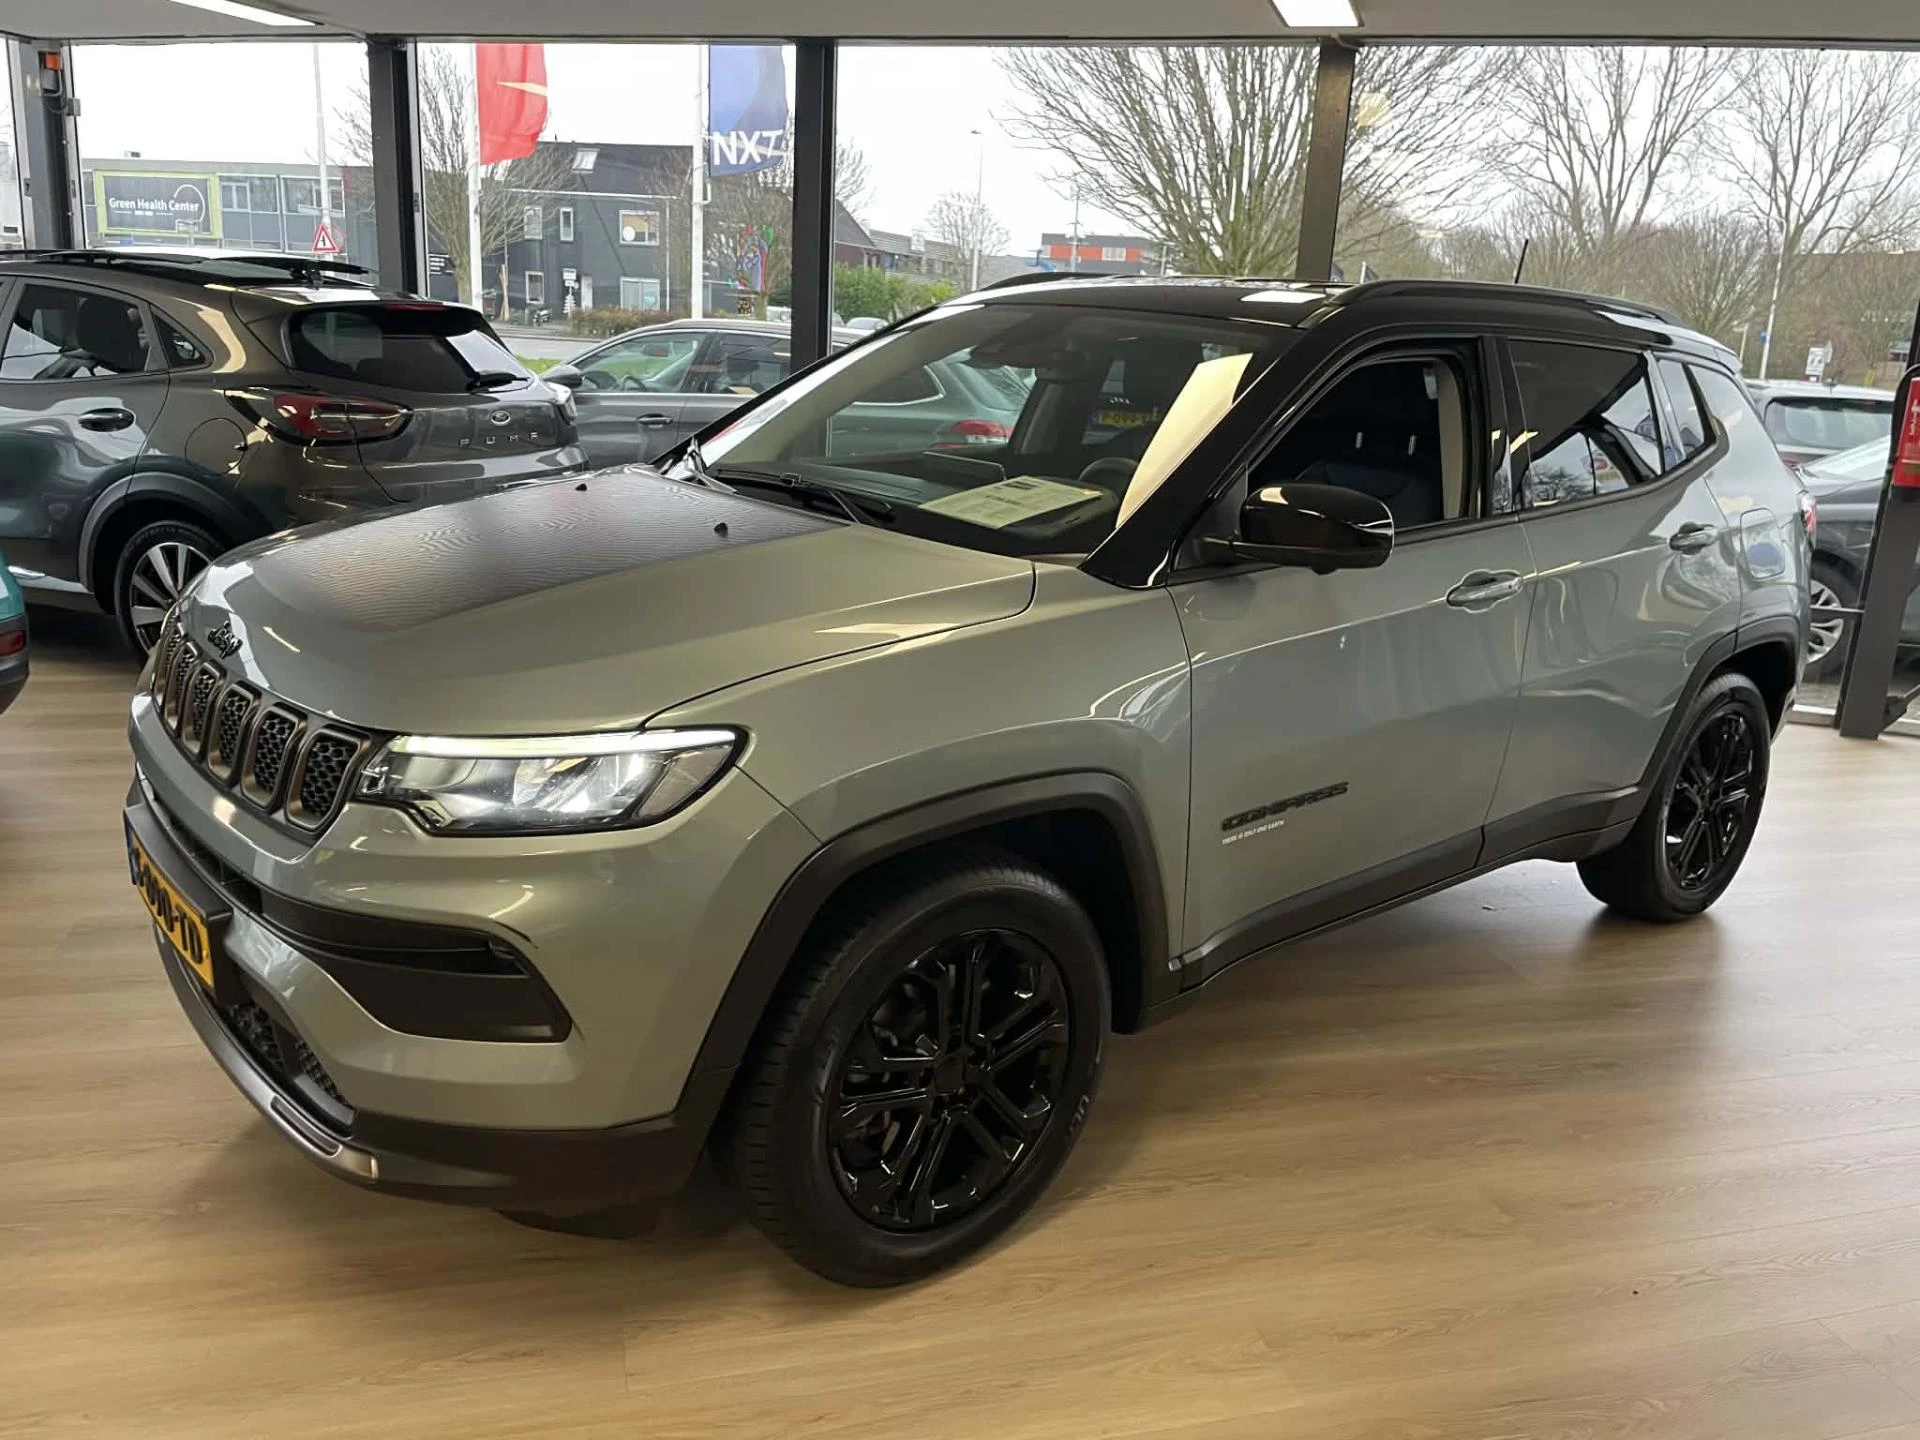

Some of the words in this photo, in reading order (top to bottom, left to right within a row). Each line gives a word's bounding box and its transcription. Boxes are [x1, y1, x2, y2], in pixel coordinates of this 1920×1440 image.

[712, 129, 784, 166] NXT
[108, 197, 136, 209] Green
[137, 198, 167, 211] Health
[168, 199, 200, 212] Center
[207, 620, 244, 659] Jeep
